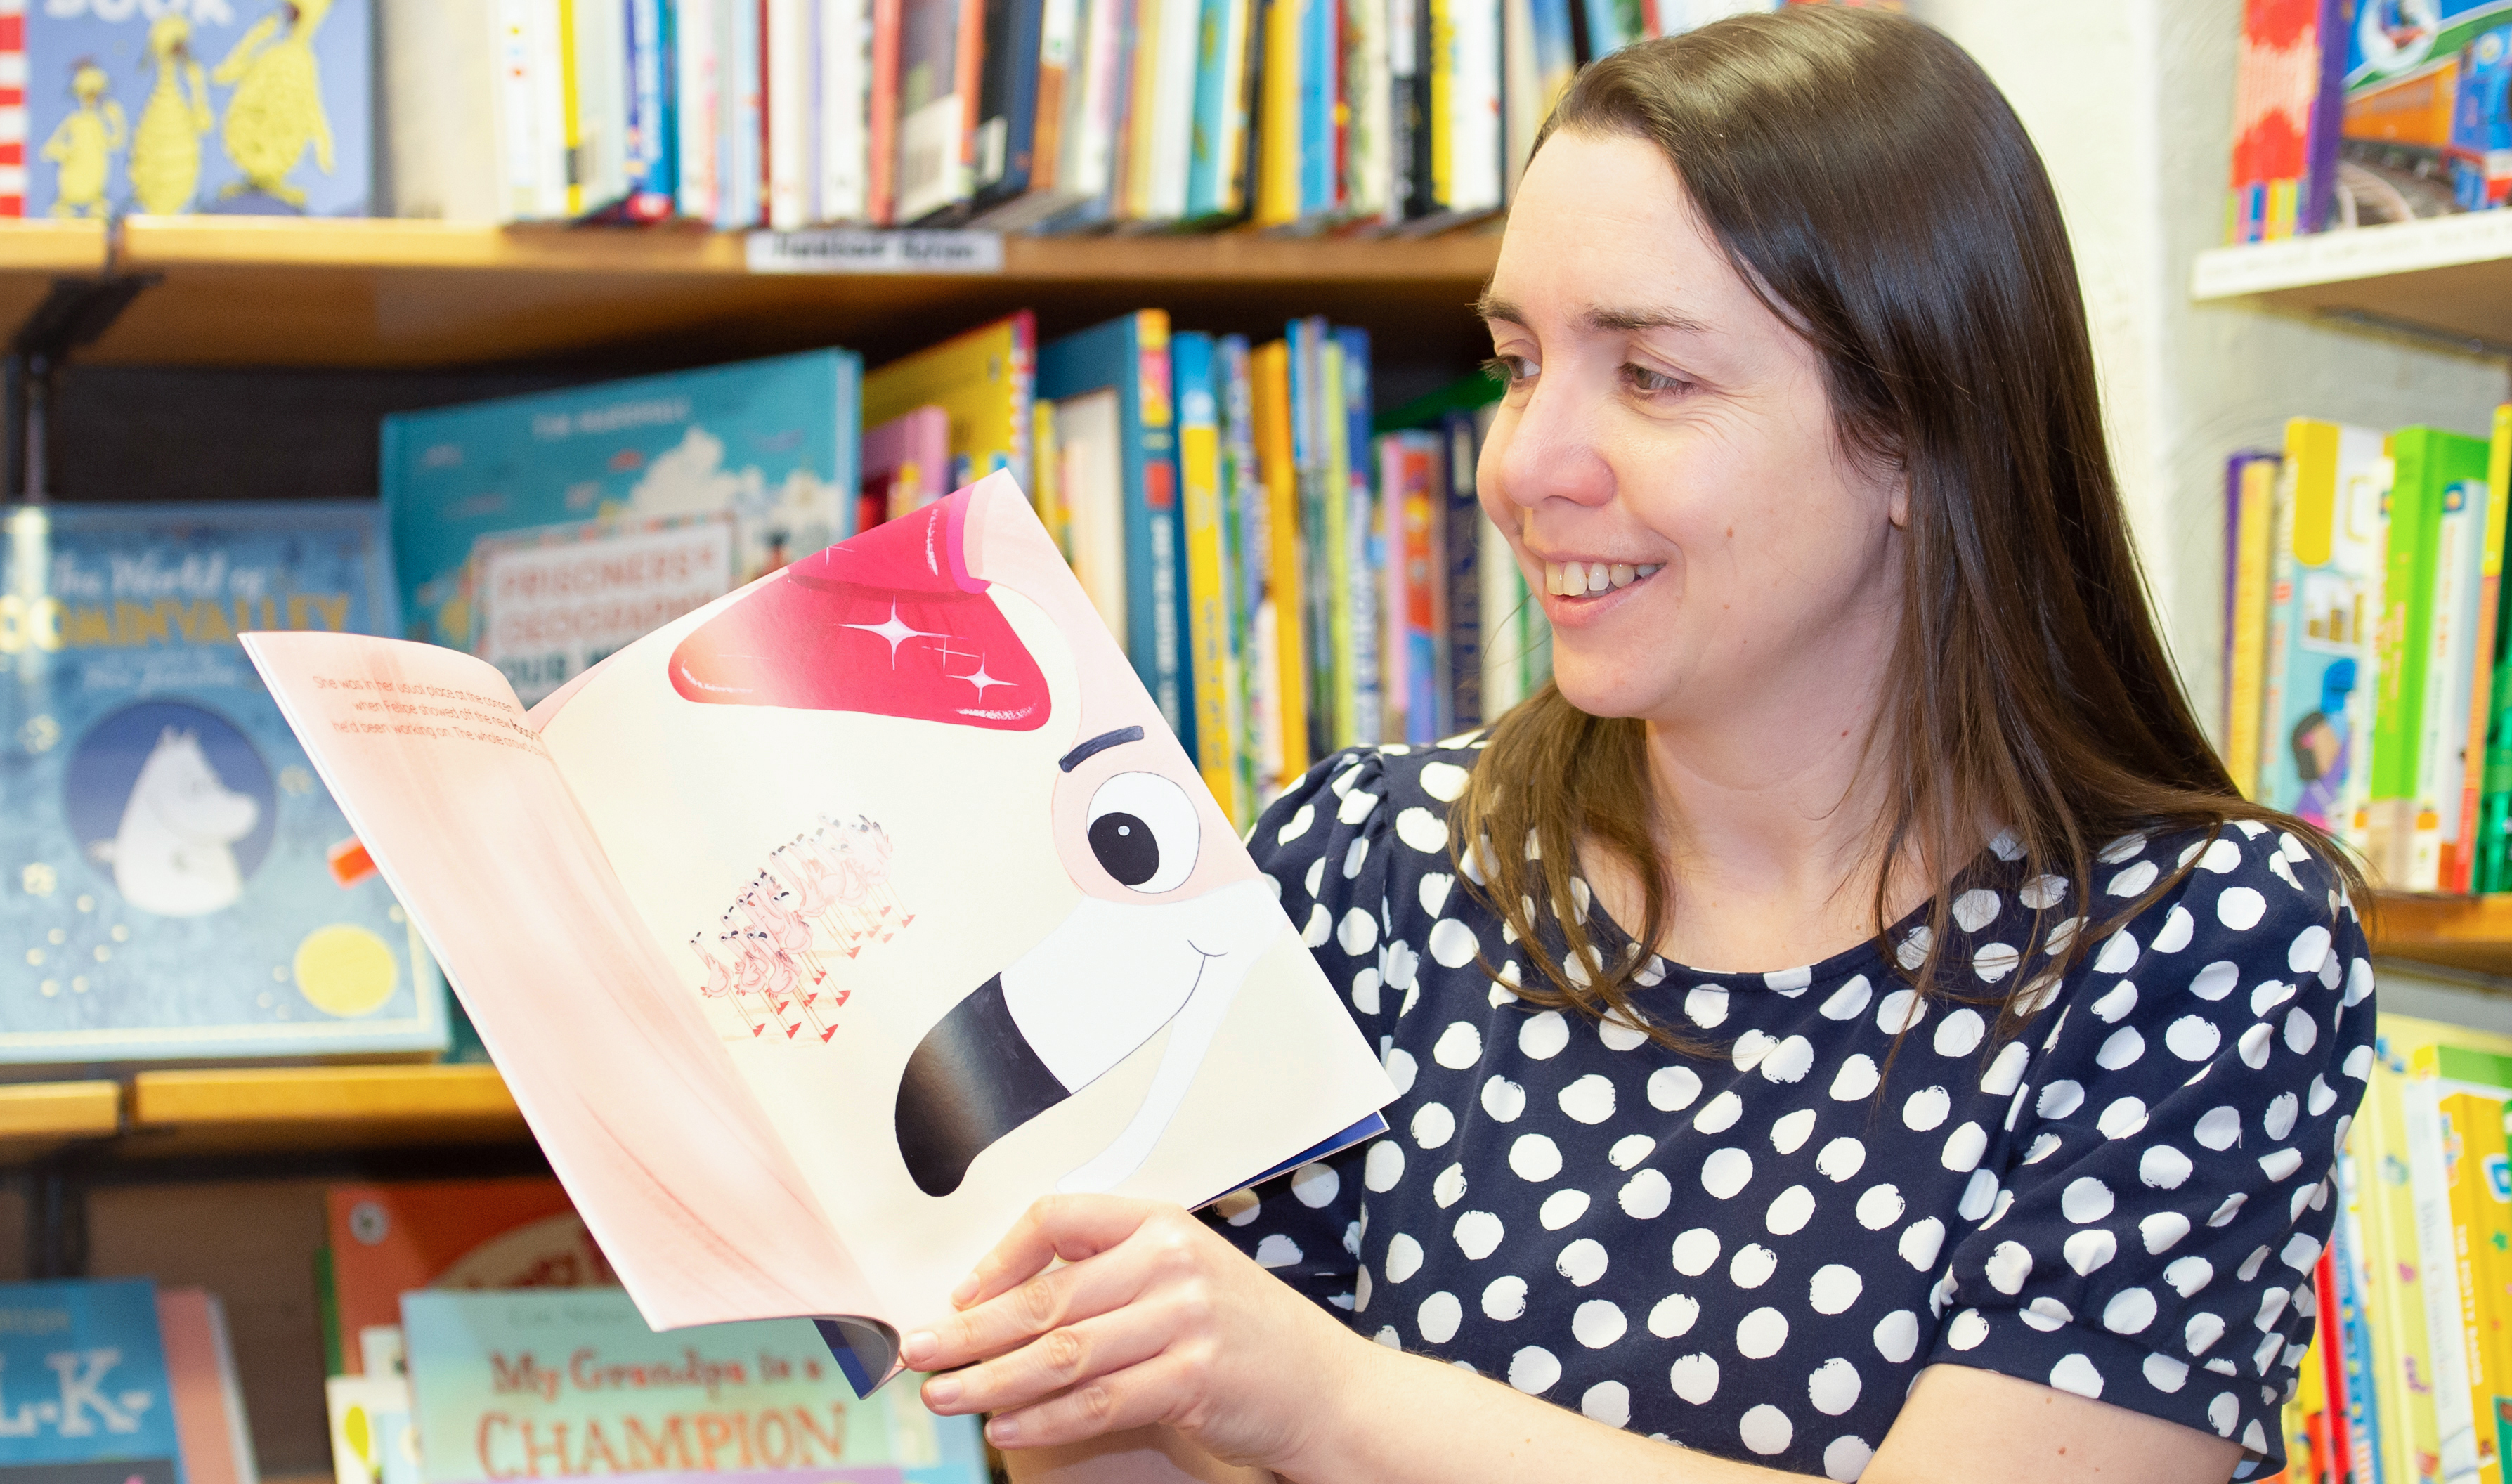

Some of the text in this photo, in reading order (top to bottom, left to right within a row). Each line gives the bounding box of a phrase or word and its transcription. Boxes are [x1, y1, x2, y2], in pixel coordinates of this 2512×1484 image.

[0, 594, 348, 651] OOMINVALLEY
[313, 676, 338, 689] She
[339, 679, 364, 690] was
[363, 679, 376, 691] in
[374, 678, 394, 692] her
[396, 682, 426, 694] usual
[426, 684, 455, 698] place
[455, 690, 467, 701] at
[466, 689, 483, 704] the
[331, 720, 360, 734] he'd
[358, 720, 391, 734] been
[391, 722, 437, 739] working
[451, 726, 475, 741] The
[474, 730, 504, 745] whole
[353, 700, 511, 729] when Felipe showed off the new
[490, 1349, 559, 1402] My
[568, 1344, 747, 1401] Grandpa
[758, 1349, 791, 1385] is
[476, 1402, 846, 1481] CHAMPION
